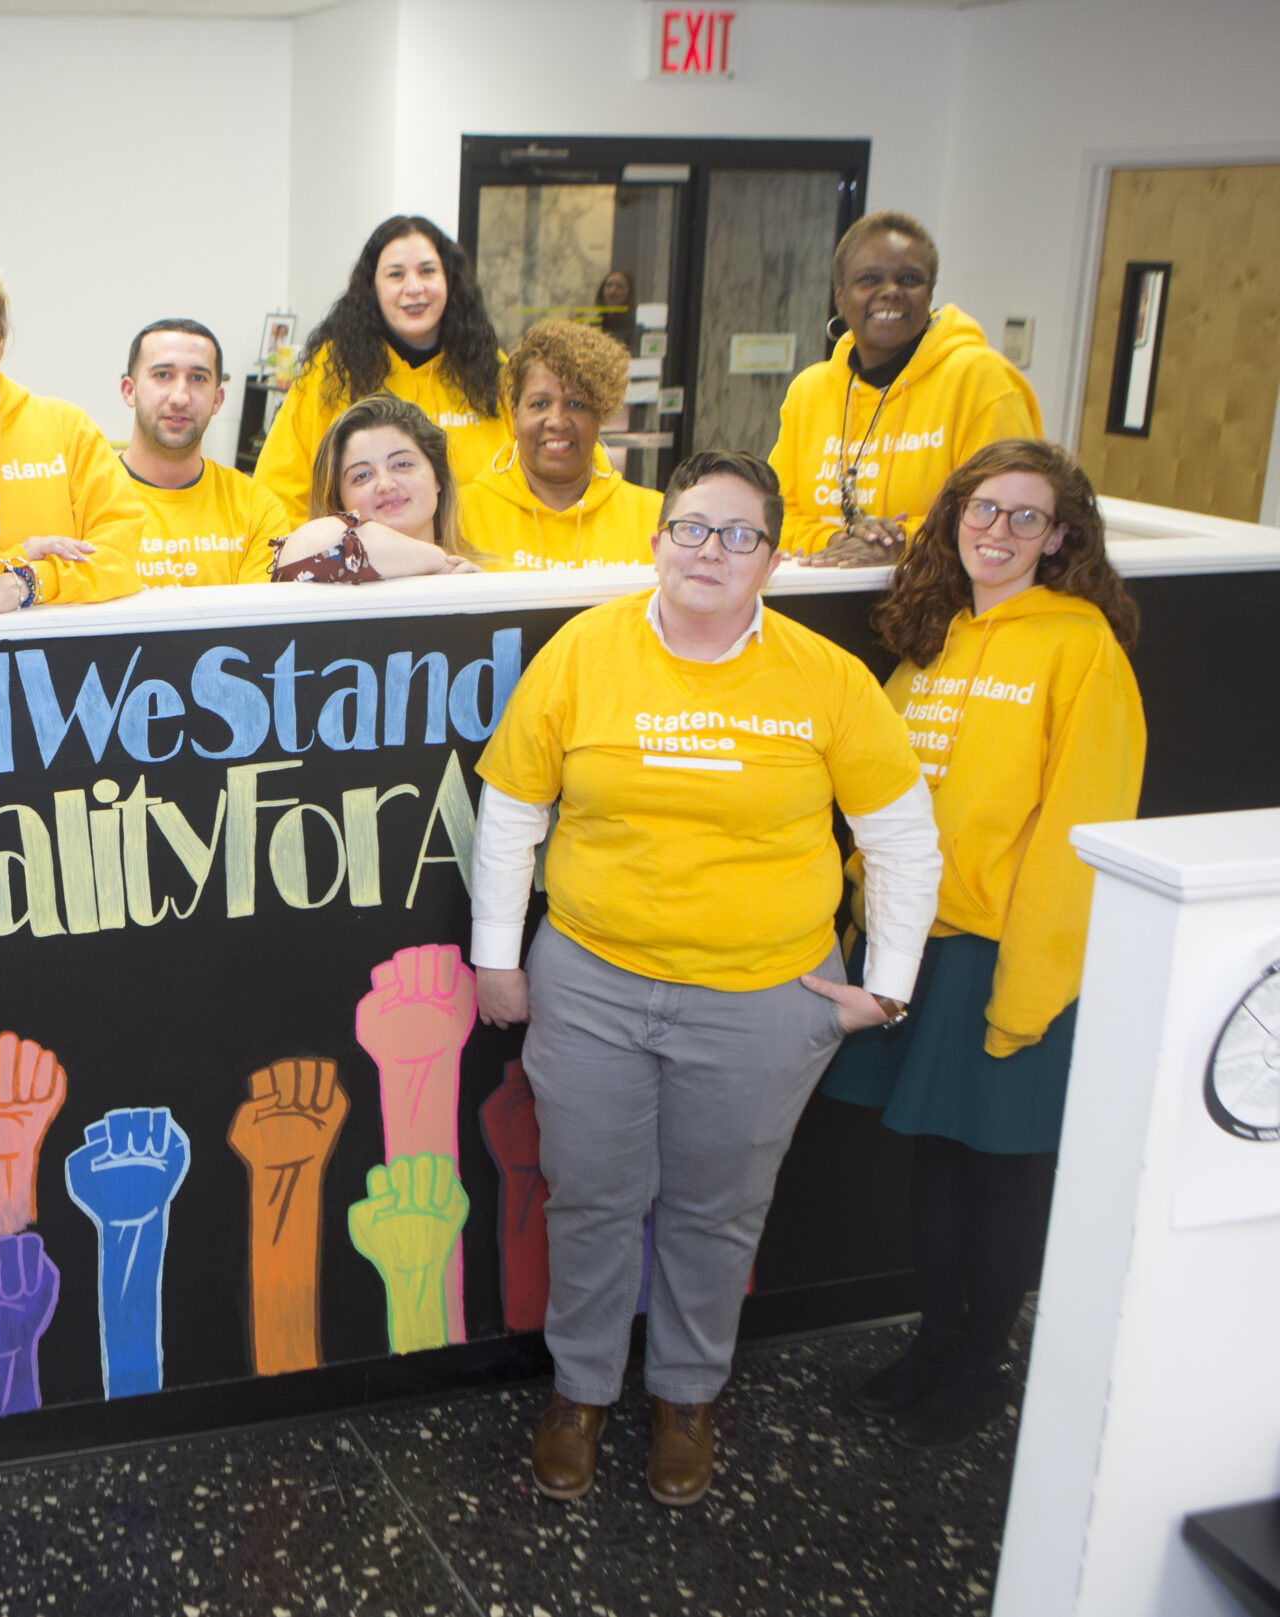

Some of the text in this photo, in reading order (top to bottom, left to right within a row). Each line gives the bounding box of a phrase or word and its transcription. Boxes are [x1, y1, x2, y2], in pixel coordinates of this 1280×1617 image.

[661, 10, 736, 74] EXIT
[815, 460, 880, 480] Juce
[814, 484, 877, 506] Ceer
[136, 557, 198, 578] Justce
[969, 676, 1035, 705] Island
[635, 710, 725, 732] Staten
